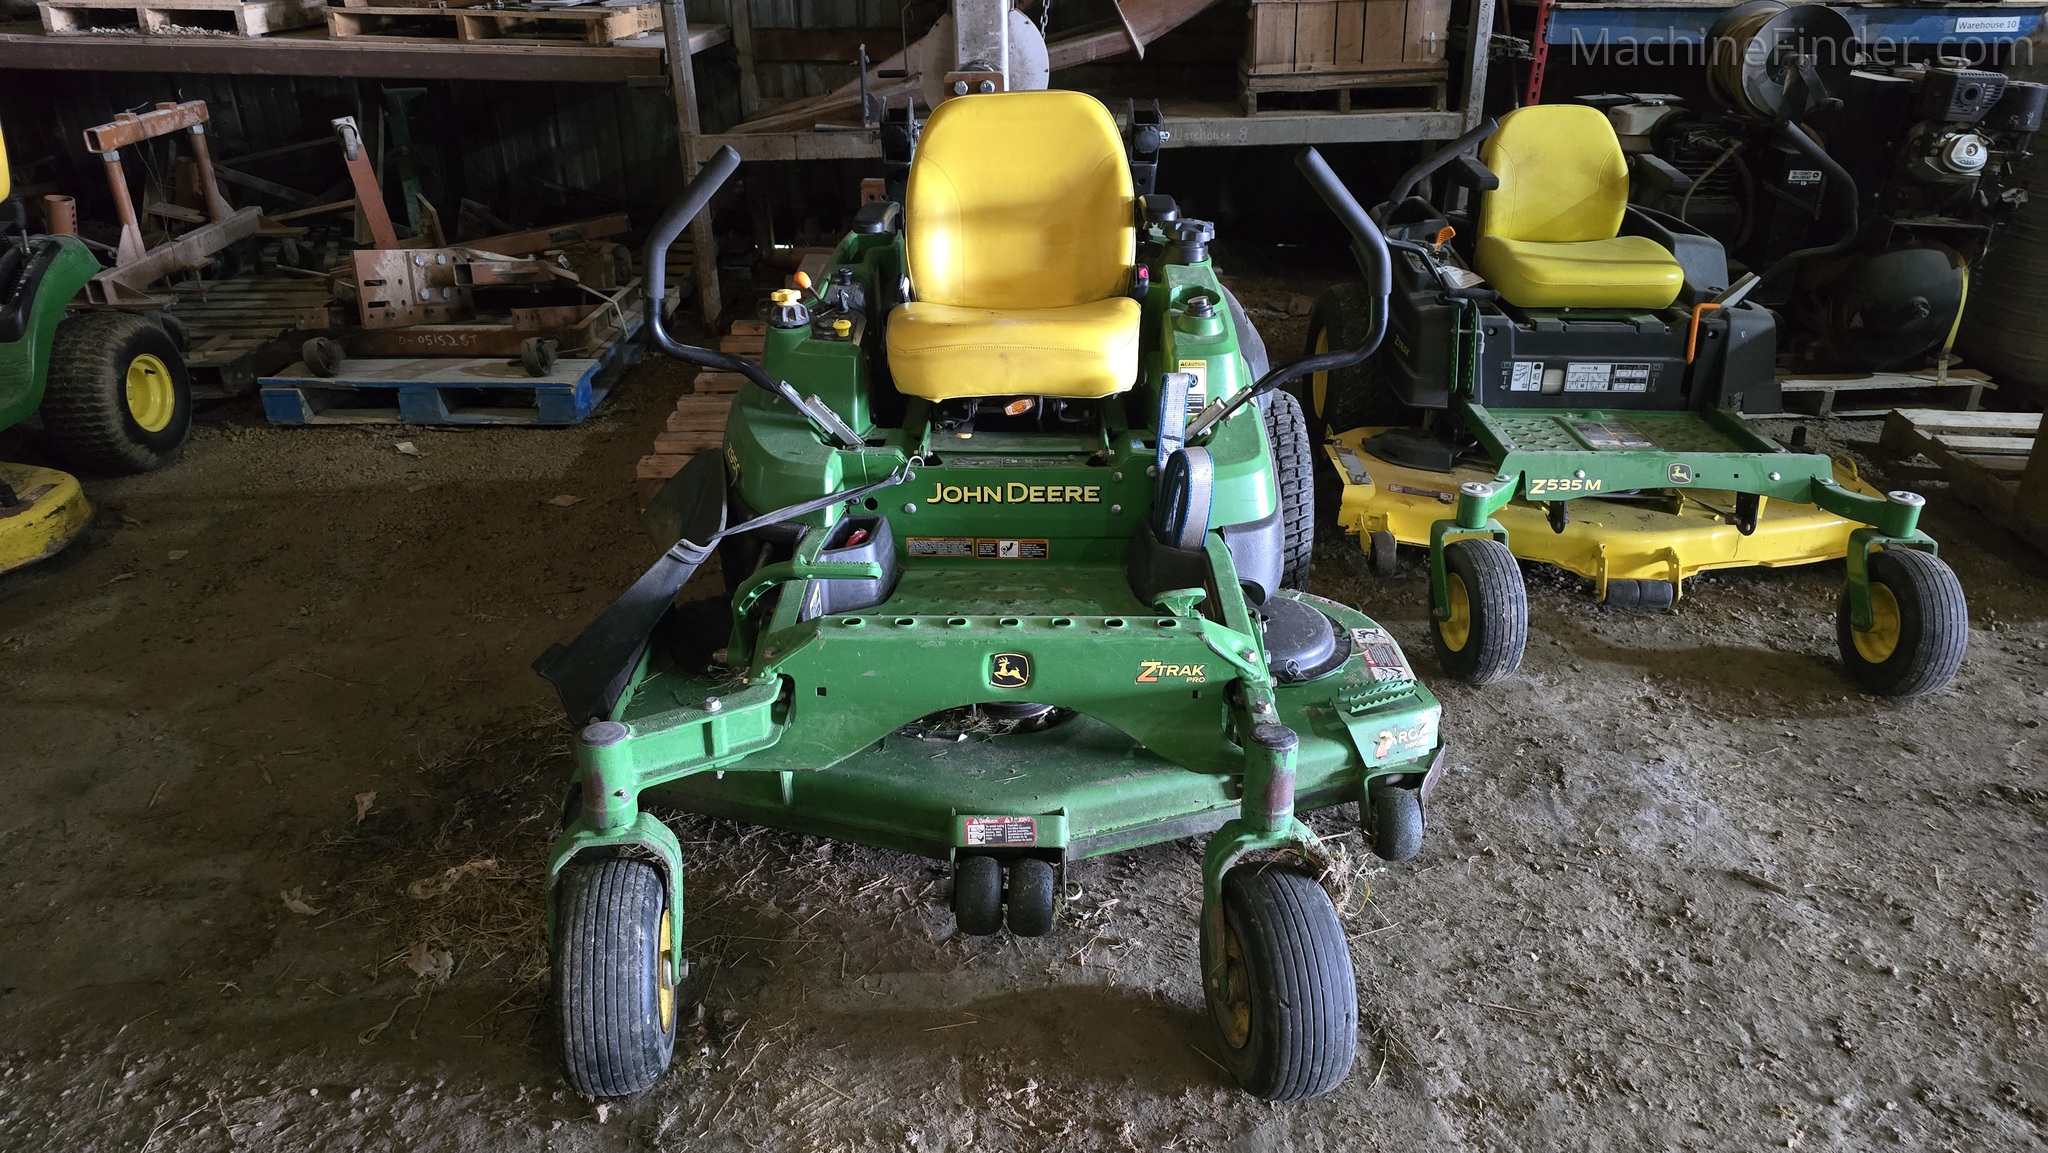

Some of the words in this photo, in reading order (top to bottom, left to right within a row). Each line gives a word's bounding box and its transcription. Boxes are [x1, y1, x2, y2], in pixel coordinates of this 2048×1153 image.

[1958, 21, 2005, 29] Warehouse
[2006, 20, 2017, 28] 10
[926, 482, 1003, 504] JOHN
[1007, 482, 1102, 504] DEERE
[1136, 660, 1207, 683] ZTRAK
